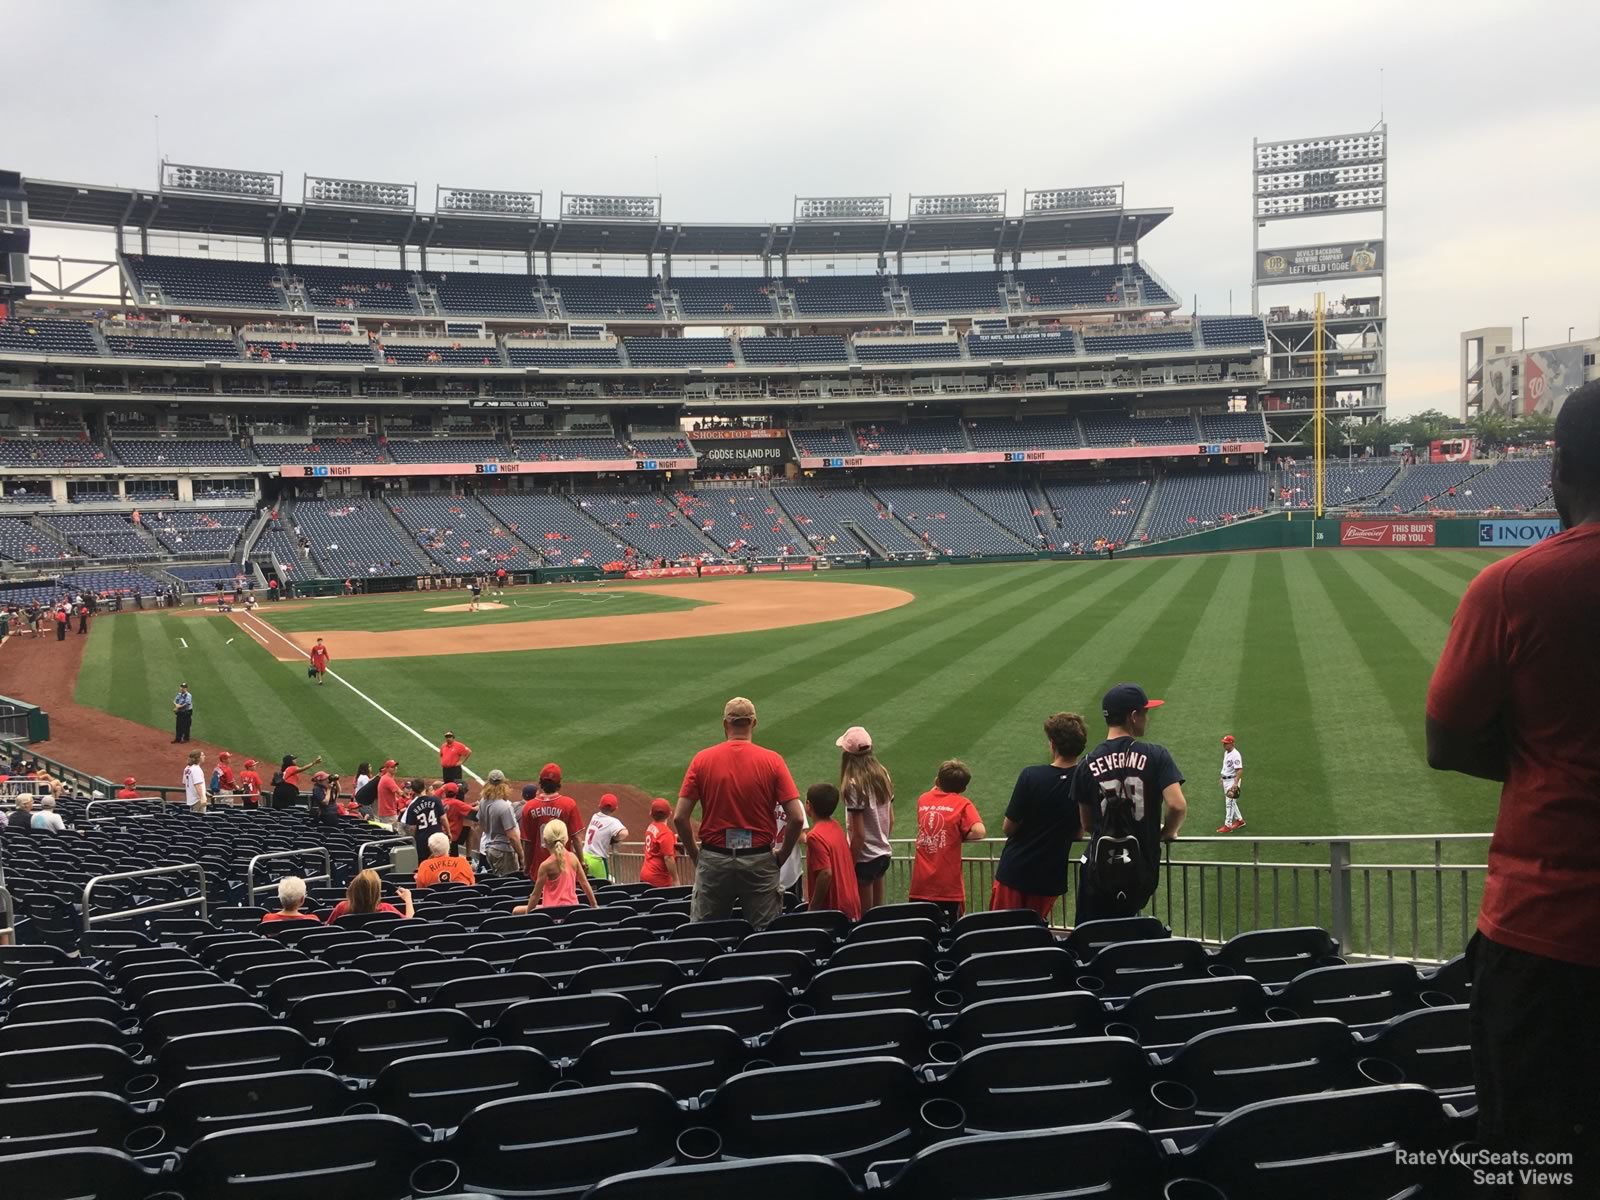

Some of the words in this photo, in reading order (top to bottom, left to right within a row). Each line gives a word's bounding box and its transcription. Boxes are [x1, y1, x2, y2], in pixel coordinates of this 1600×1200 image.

[1296, 249, 1314, 257] DEVILS
[1289, 266, 1305, 274] LEFT
[1307, 264, 1326, 272] FIELD
[1327, 262, 1349, 271] LODGE
[693, 431, 724, 439] SHOCK
[729, 430, 748, 438] TOP
[1222, 445, 1242, 453] NIGHT
[708, 449, 734, 460] GOOSE
[736, 449, 763, 459] ISLAND
[764, 448, 781, 458] PUB
[1027, 452, 1045, 460] NIGHT
[658, 461, 677, 469] NIGHT
[844, 458, 863, 466] NIGHT
[330, 467, 351, 475] NIGHT
[500, 464, 520, 472] NIGHT
[1347, 528, 1383, 537] Budweiser
[1392, 524, 1409, 533] THIS
[1410, 524, 1433, 533] BUD'S
[1499, 525, 1557, 540] INOVA
[1392, 534, 1407, 542] FOR
[1408, 534, 1426, 542] YOU.
[1089, 752, 1147, 777] SEVERINO
[413, 801, 436, 815] HARPER
[530, 807, 562, 818] RENDON
[416, 810, 438, 830] 34
[587, 829, 596, 845] 7
[428, 861, 458, 872] RIPKEN
